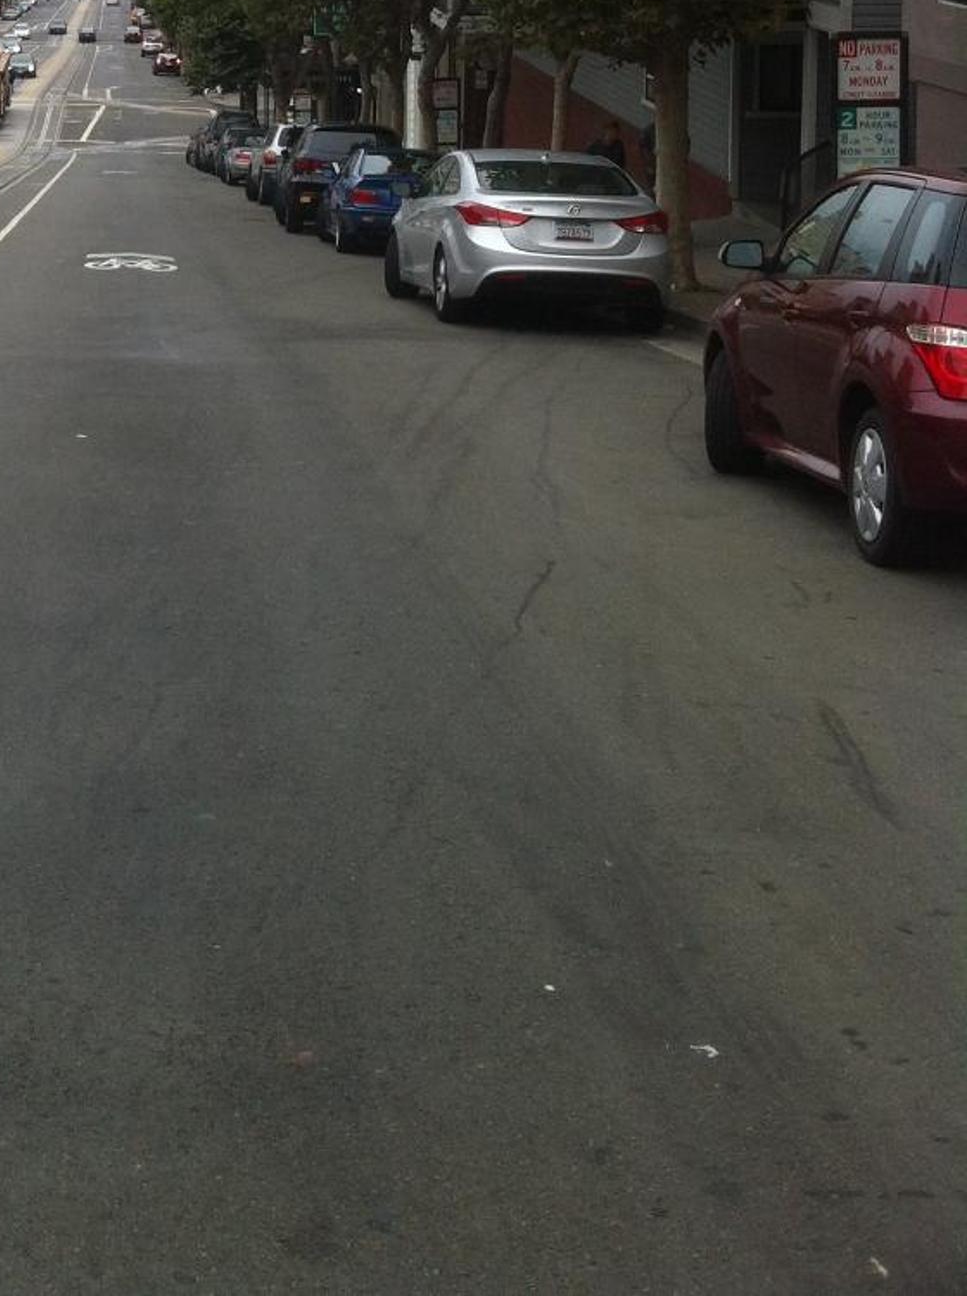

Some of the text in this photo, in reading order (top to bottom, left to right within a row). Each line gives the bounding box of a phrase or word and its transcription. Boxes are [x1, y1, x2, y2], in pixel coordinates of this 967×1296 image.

[838, 39, 899, 57] NO PARKING
[848, 76, 889, 88] MONDAY
[841, 111, 854, 127] 2
